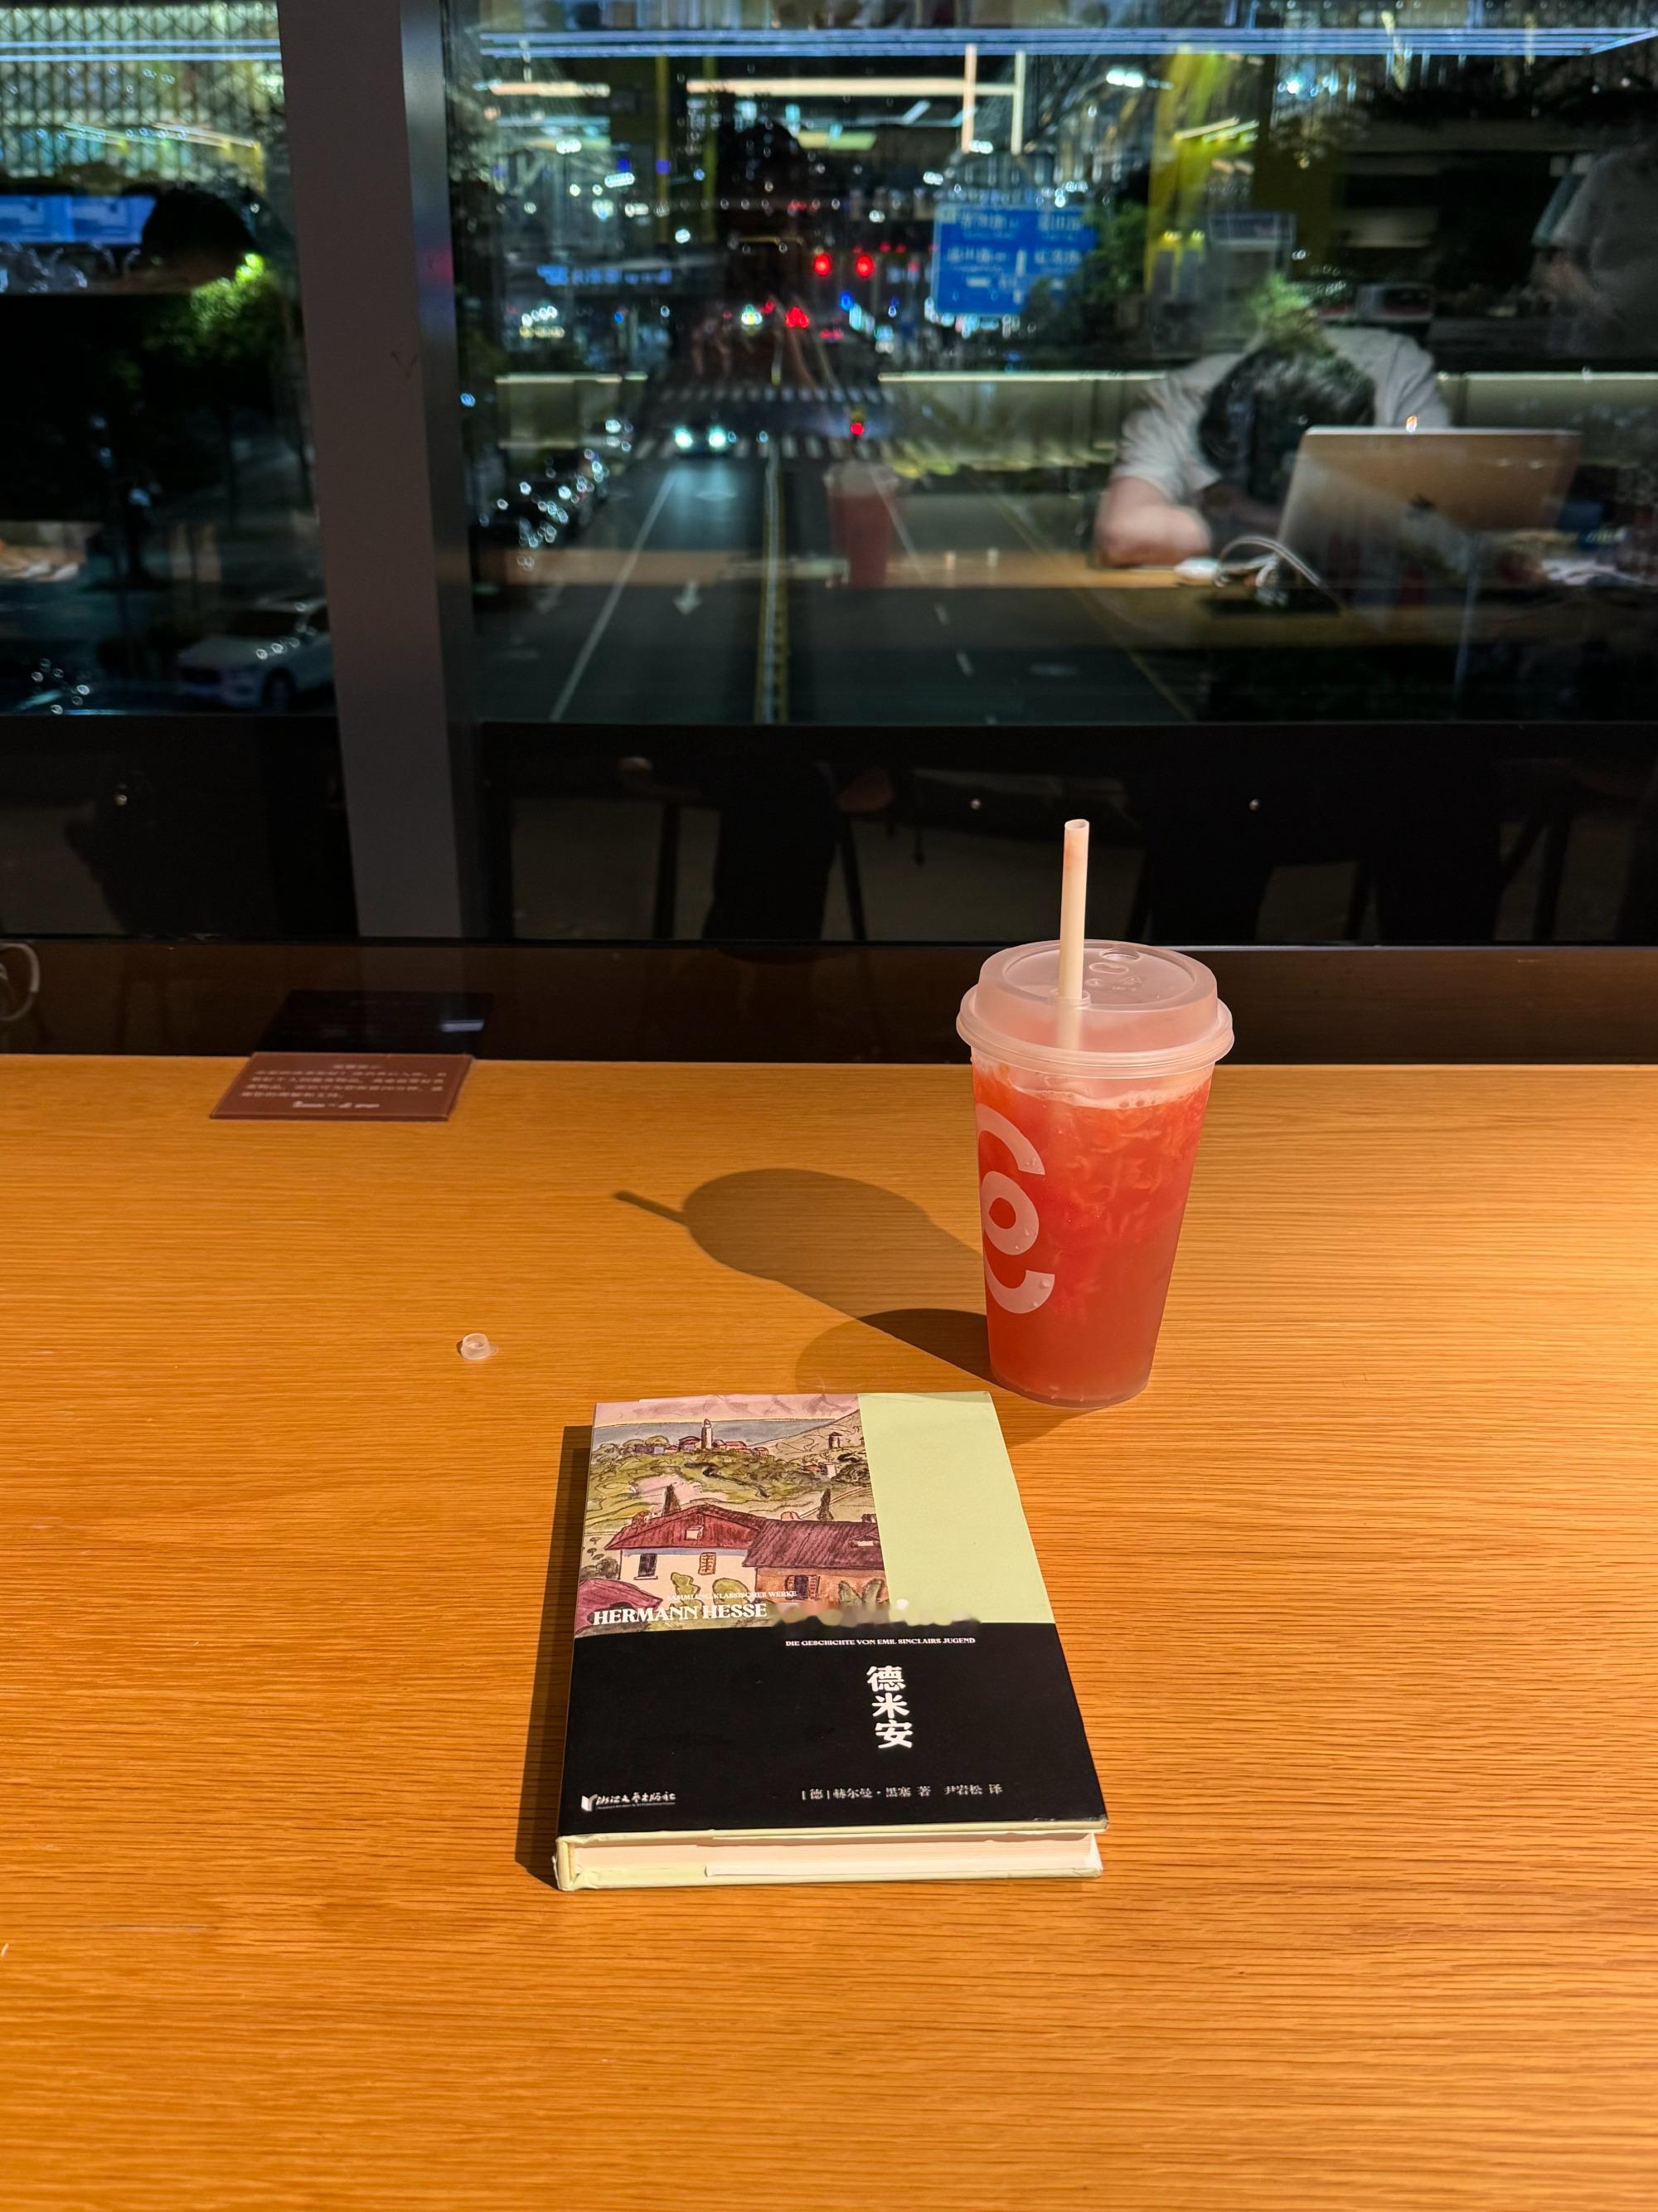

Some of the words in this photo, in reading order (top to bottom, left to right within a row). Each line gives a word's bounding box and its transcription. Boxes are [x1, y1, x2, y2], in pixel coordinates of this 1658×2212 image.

[768, 1590, 797, 1598] WERKE
[593, 1605, 698, 1626] HERMANN
[702, 1603, 768, 1621] HESSE
[942, 1637, 977, 1645] JUGEND
[865, 1665, 914, 1749] 德米安
[917, 1785, 931, 1797] 著
[943, 1784, 983, 1796] 尹岩松
[988, 1783, 1003, 1795] 译
